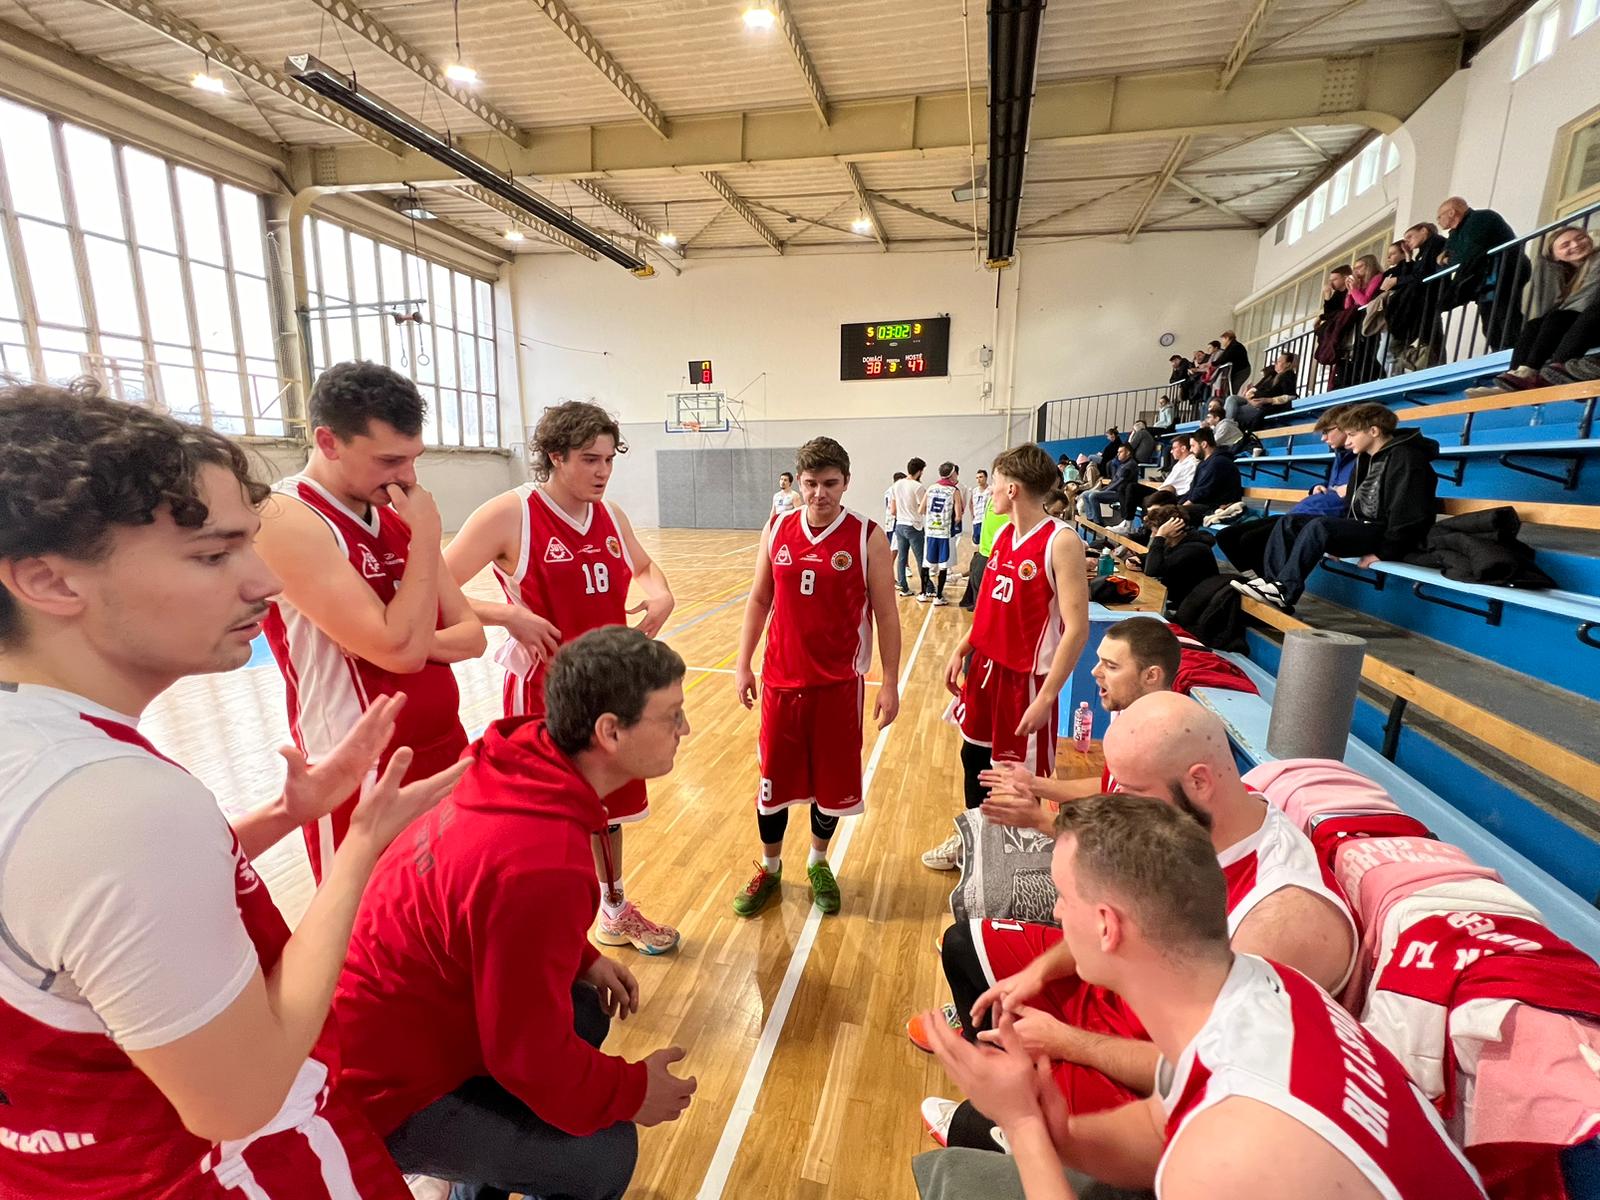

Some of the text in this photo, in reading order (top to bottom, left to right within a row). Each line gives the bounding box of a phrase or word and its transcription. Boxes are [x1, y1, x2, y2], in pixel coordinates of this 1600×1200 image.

[878, 324, 910, 339] 03:02
[913, 323, 921, 334] 3
[866, 362, 882, 374] 38
[889, 362, 897, 373] 3
[907, 359, 924, 372] 47
[582, 562, 609, 594] 18
[800, 569, 816, 596] 8
[991, 574, 1014, 604] 20
[760, 778, 772, 801] 8
[1342, 1076, 1390, 1149] BK
